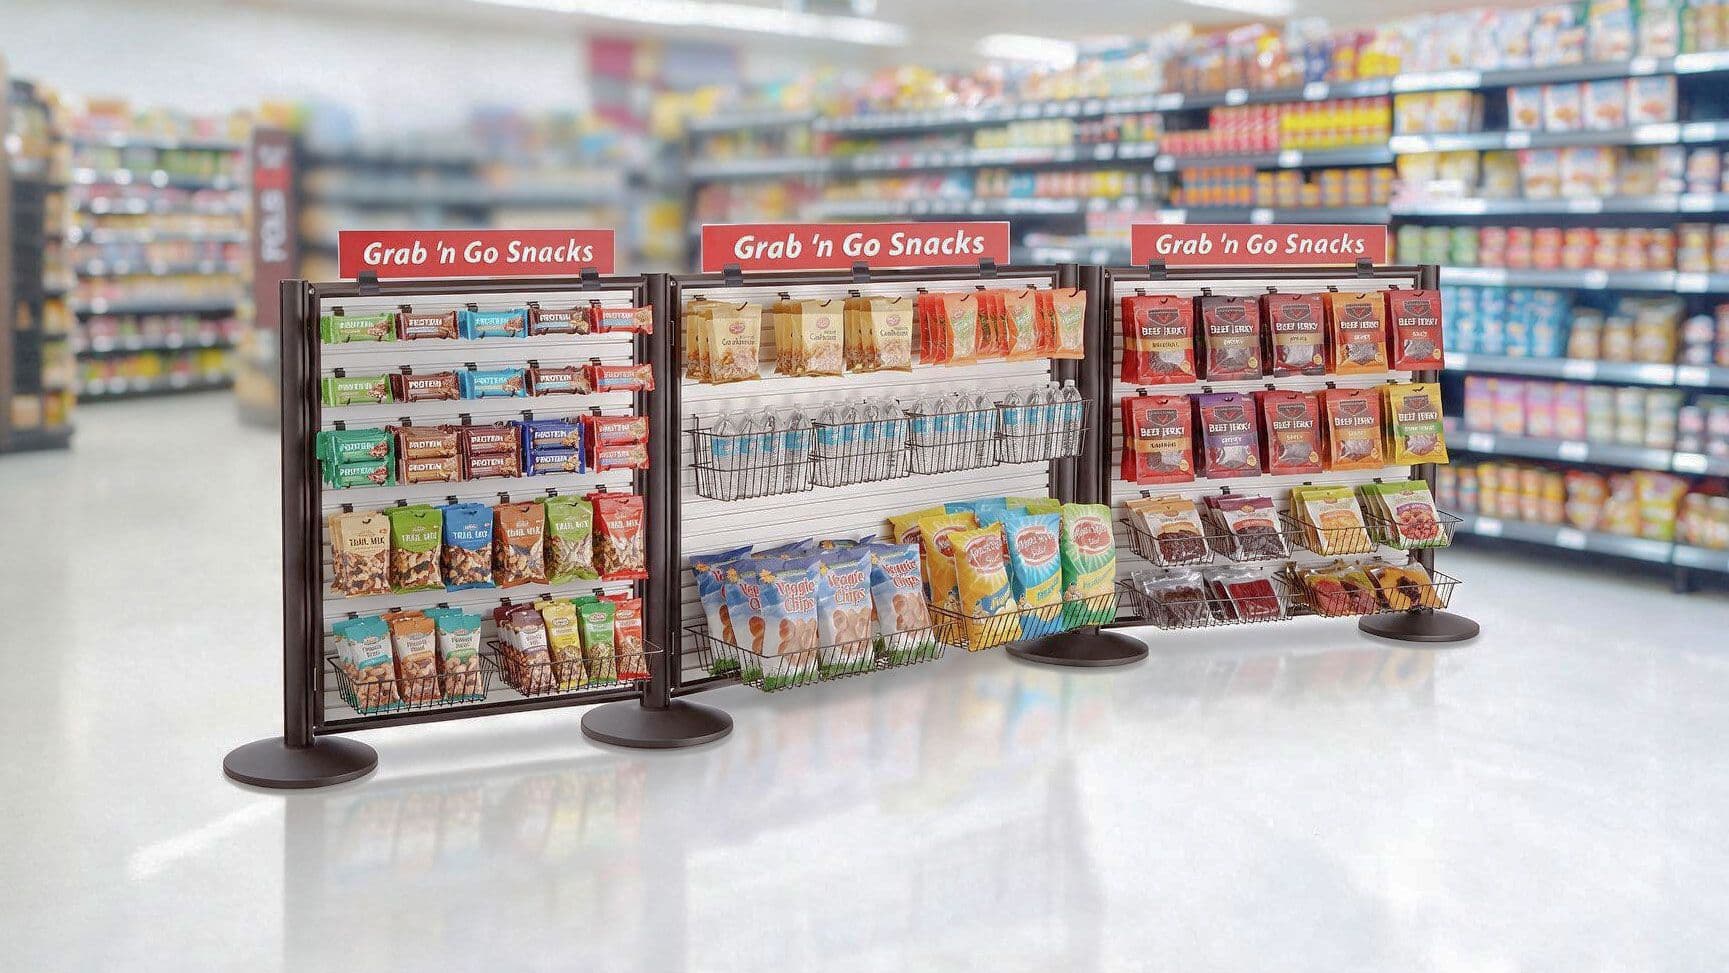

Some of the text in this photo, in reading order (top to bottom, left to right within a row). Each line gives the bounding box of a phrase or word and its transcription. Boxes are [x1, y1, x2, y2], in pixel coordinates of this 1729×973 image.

[734, 232, 802, 260] Grab
[842, 232, 881, 257] Go
[889, 230, 985, 256] Snacks
[1155, 232, 1213, 255] Grab
[1246, 233, 1278, 254] Go
[1285, 232, 1365, 254] Snacks
[363, 240, 428, 266] Grab
[463, 240, 498, 264] Go
[506, 238, 594, 263] Snacks
[409, 380, 442, 388] PROTEIN
[540, 374, 572, 382] PROTEIN
[1209, 422, 1251, 432] BEEF JERKY
[1274, 420, 1313, 429] BEEF JERKY
[471, 458, 504, 467] PROTEIN
[535, 455, 568, 464] PROTEIN
[775, 579, 816, 598] Veggie
[835, 587, 866, 605] Chips
[784, 595, 816, 613] Chips
